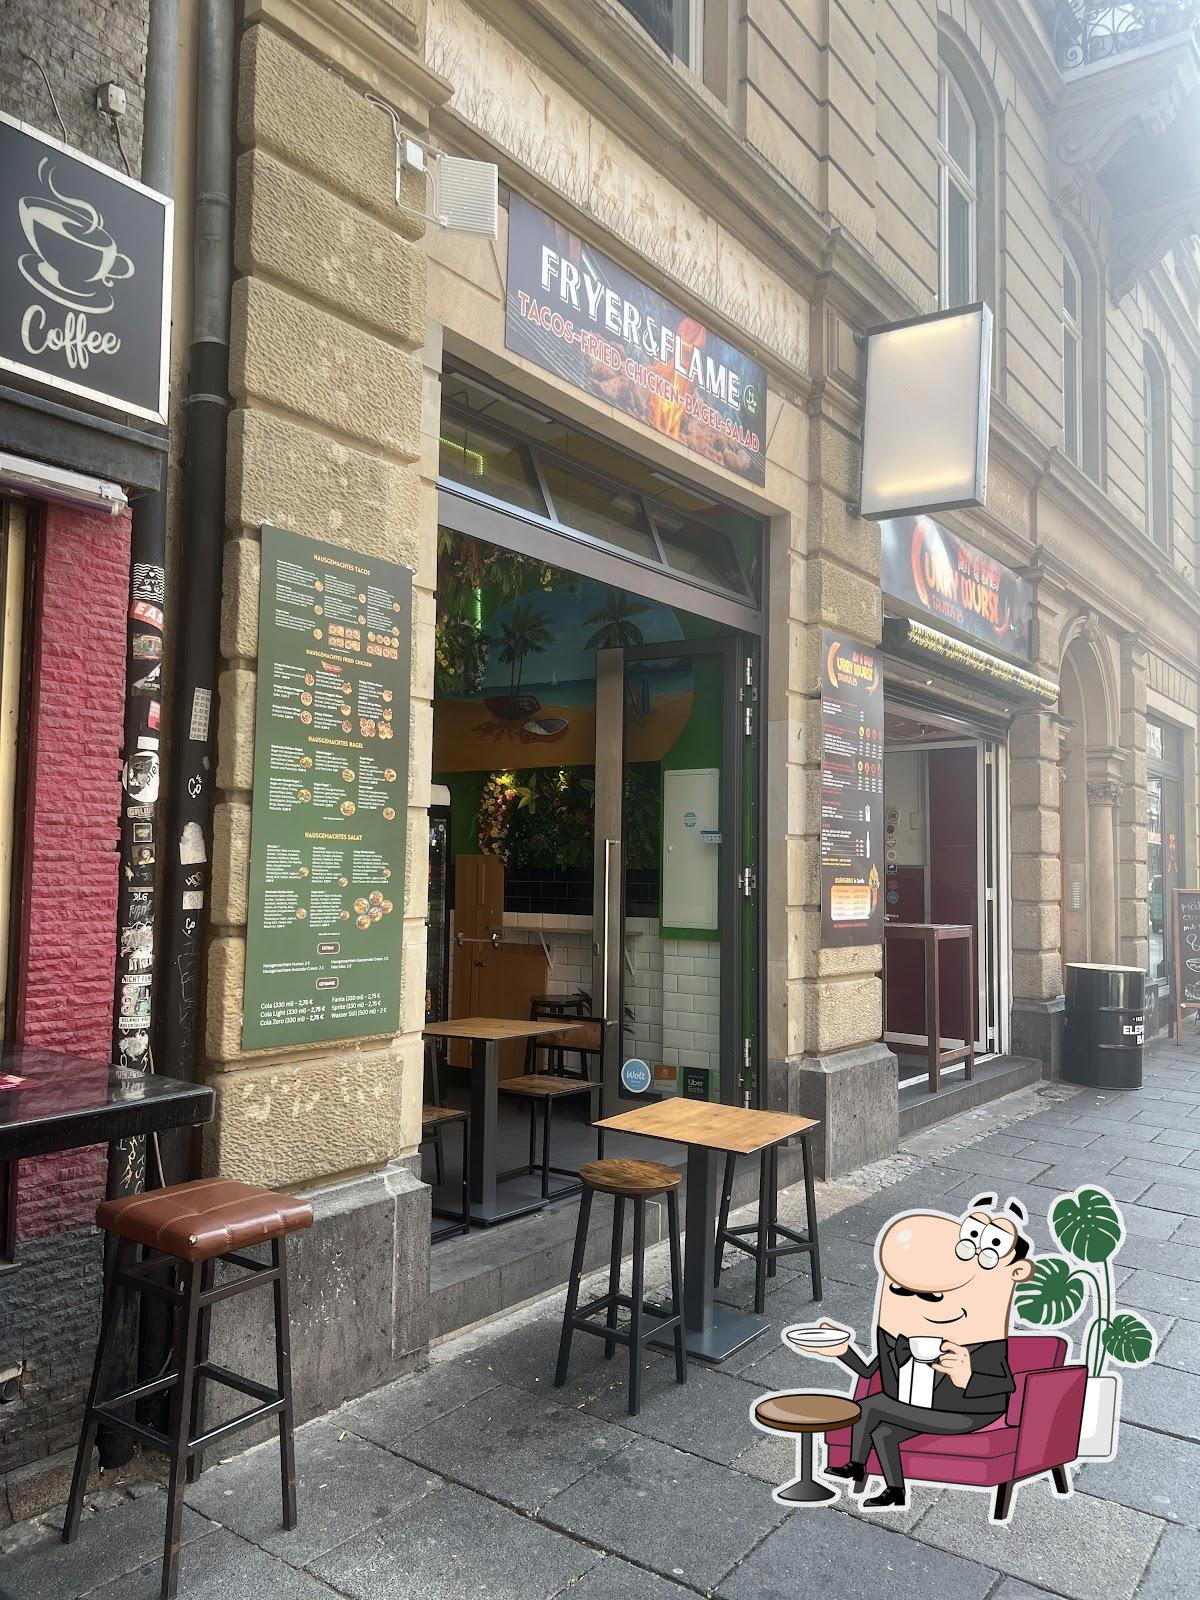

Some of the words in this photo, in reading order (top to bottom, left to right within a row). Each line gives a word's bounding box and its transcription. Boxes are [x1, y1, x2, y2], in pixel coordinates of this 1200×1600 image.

[21, 304, 121, 370] Coffee
[354, 566, 371, 576] TACOS
[273, 1009, 286, 1018] Light
[273, 1017, 284, 1025] Zero
[626, 1070, 646, 1080] Wolt
